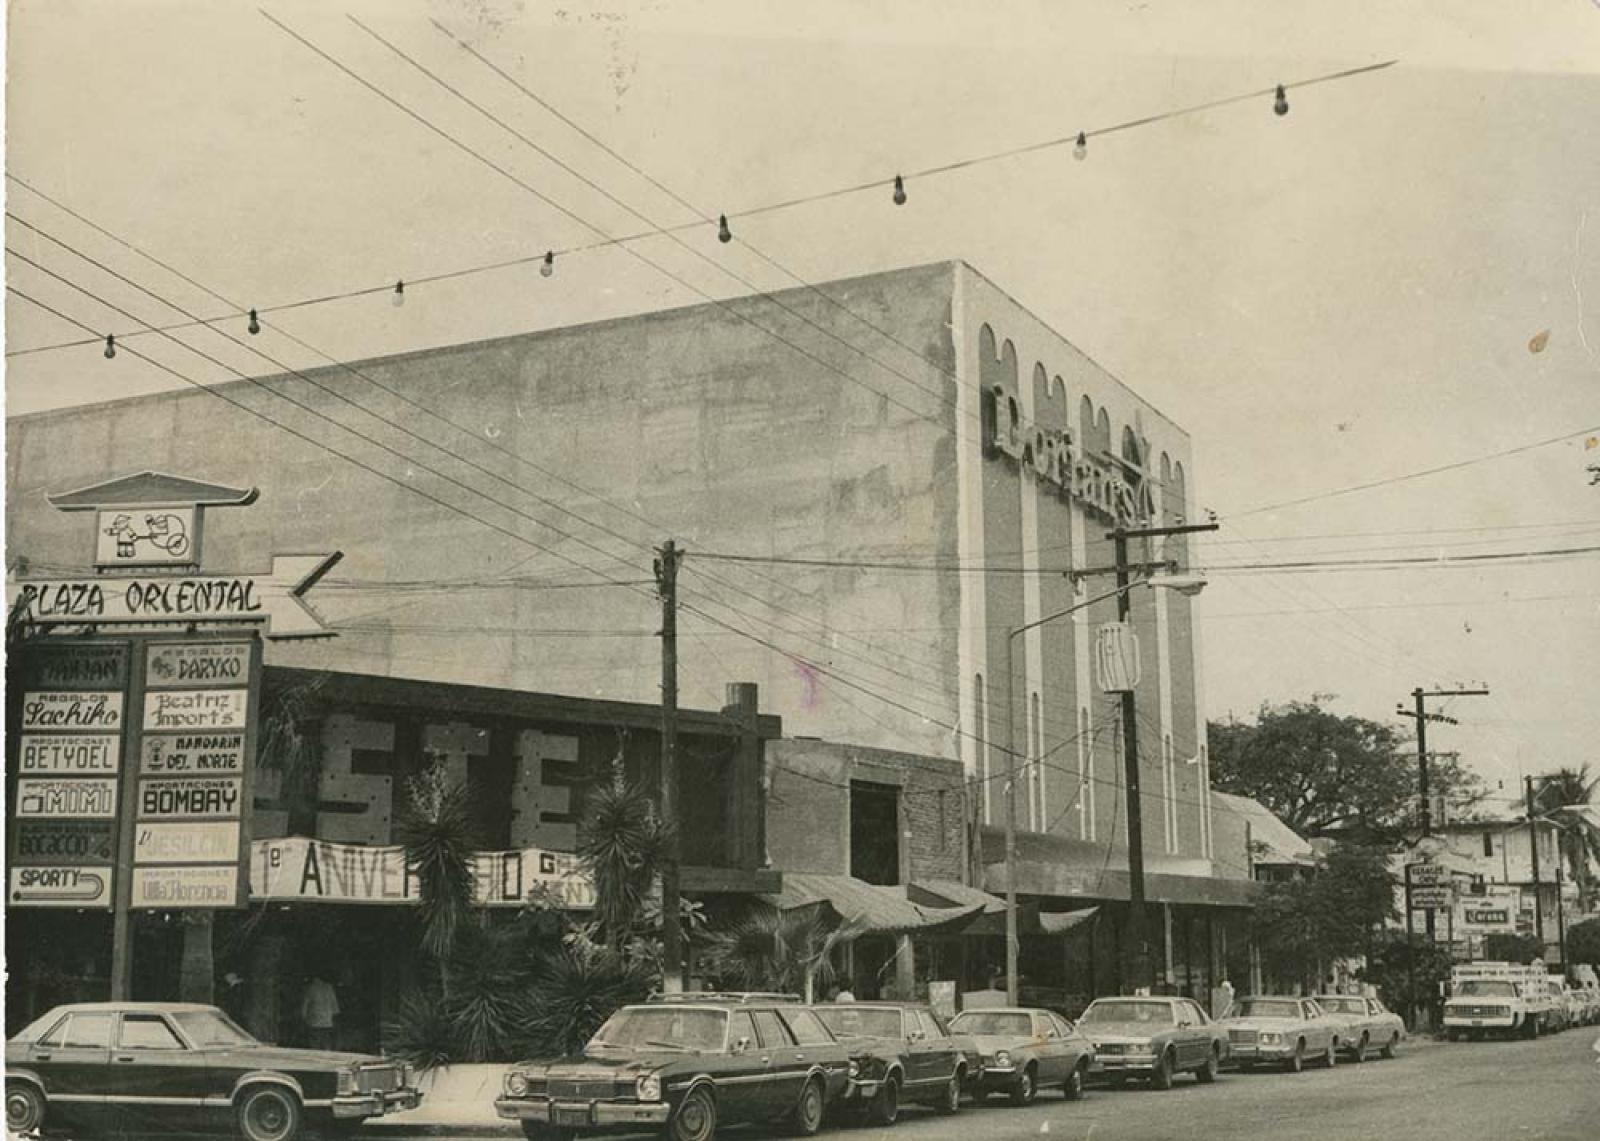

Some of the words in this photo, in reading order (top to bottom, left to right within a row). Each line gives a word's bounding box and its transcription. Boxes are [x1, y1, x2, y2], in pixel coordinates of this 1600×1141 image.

[22, 583, 104, 615] PLAZA
[125, 580, 262, 614] ORIENTAL
[178, 656, 241, 680] DARYKO
[25, 701, 118, 726] Sachiko
[156, 693, 230, 711] Beatriz
[150, 709, 234, 727] Imports
[175, 737, 241, 749] MANDARIN
[24, 746, 113, 769] BETYOEL
[167, 754, 191, 770] DEL
[197, 753, 238, 769] NORTE
[146, 781, 233, 789] IMPORTACIONES
[45, 789, 113, 813] MIMI
[143, 789, 237, 814] BOMBAY
[19, 870, 81, 887] SPORTY
[300, 841, 521, 900] ANIVERRIO
